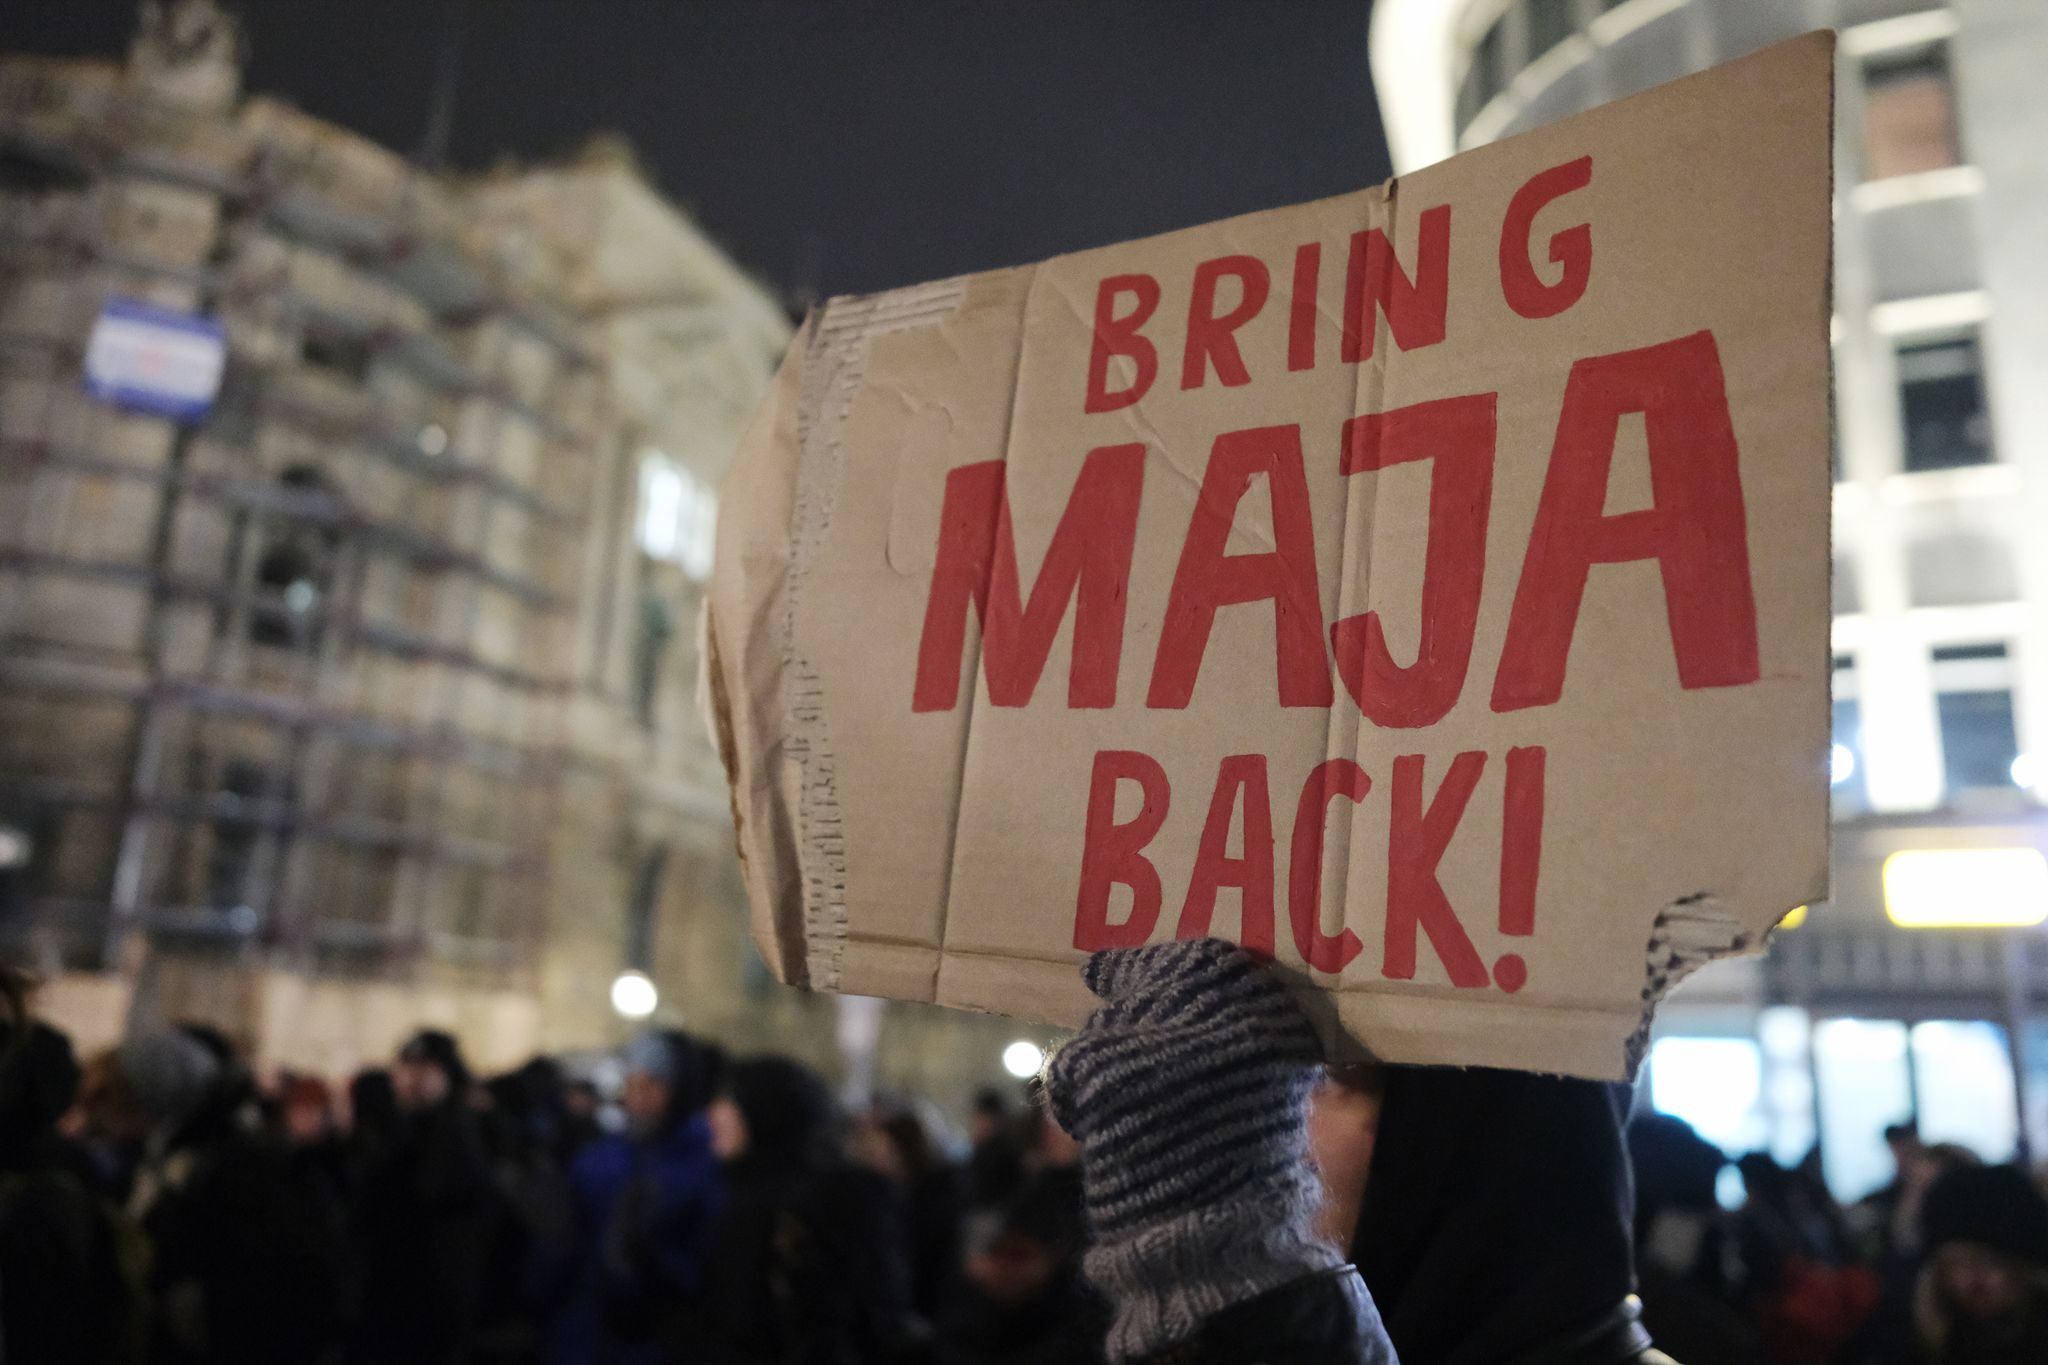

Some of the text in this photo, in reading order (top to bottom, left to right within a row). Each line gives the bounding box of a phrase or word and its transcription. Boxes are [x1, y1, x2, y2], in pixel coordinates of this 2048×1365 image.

[1085, 156, 1593, 415] BRING
[912, 329, 1760, 729] MAJA
[1073, 745, 1546, 994] BACK!
